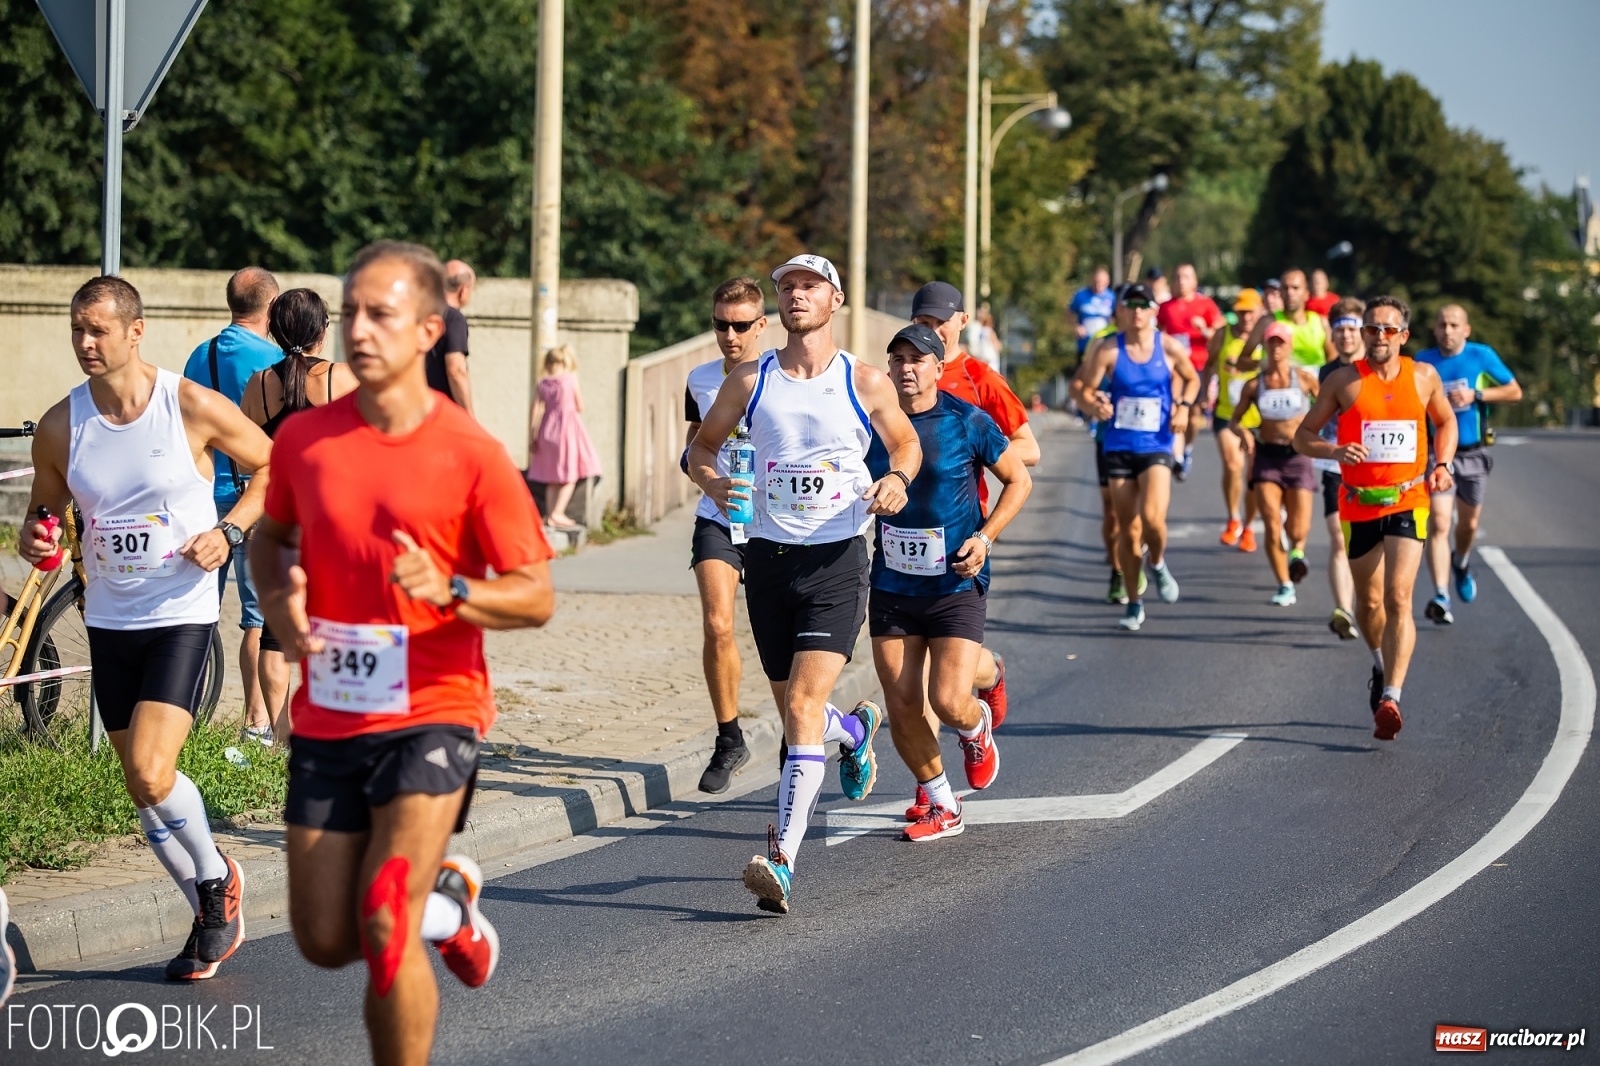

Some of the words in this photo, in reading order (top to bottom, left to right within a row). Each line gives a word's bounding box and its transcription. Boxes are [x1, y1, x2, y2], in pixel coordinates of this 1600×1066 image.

[1381, 433, 1405, 445] 179
[790, 476, 824, 494] 159
[112, 532, 150, 554] 307
[900, 541, 927, 557] 137
[331, 647, 377, 678] 349
